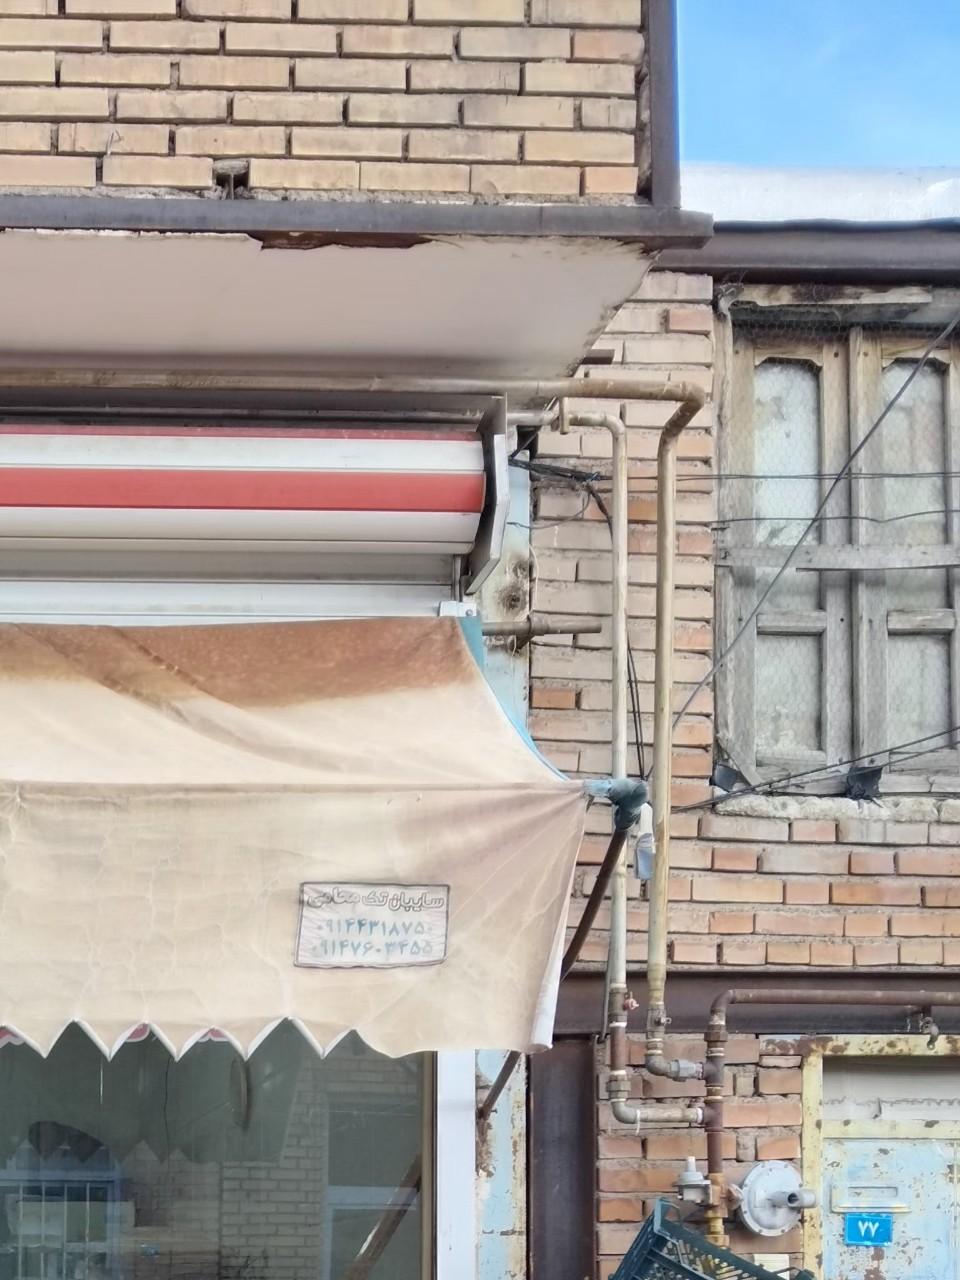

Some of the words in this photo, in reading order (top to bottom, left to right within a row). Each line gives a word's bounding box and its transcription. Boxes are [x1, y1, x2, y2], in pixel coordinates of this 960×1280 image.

[361, 888, 388, 907] تک
[387, 889, 444, 912] سایبان
[858, 1220, 879, 1238] ۷۷
